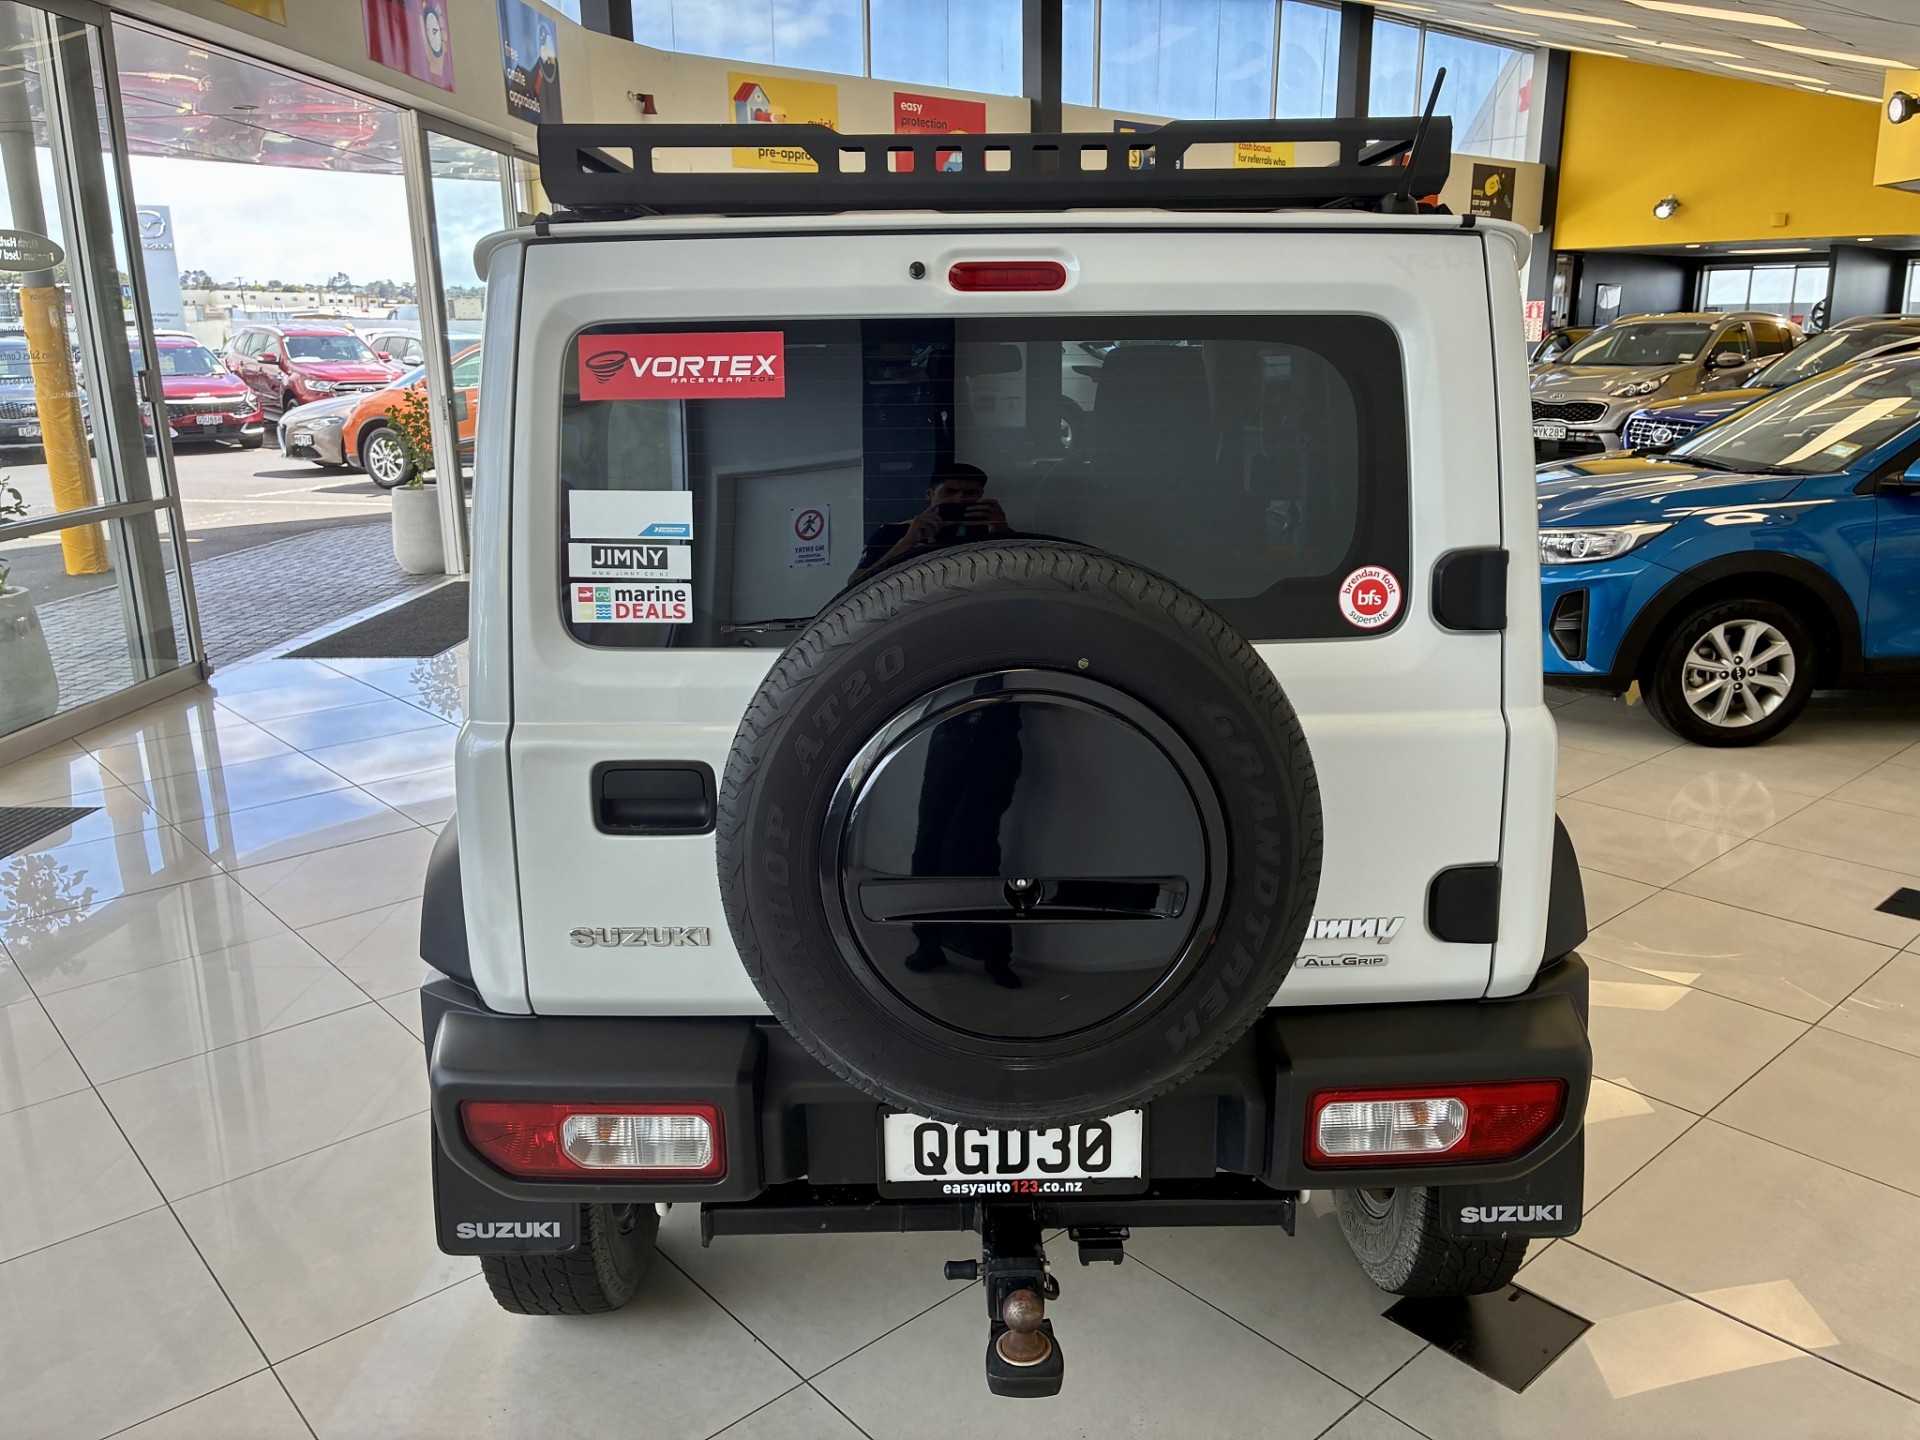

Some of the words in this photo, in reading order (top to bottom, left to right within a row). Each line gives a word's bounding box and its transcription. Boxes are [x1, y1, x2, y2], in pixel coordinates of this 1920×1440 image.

[504, 40, 519, 61] free
[507, 66, 526, 87] onsite
[509, 89, 541, 114] appraisals
[900, 101, 923, 114] easy
[901, 115, 948, 130] protection
[1238, 142, 1252, 150] cash
[1253, 144, 1272, 153] bonus
[1238, 152, 1247, 162] for
[1247, 154, 1272, 165] referrals
[1272, 157, 1286, 166] who
[629, 354, 778, 378] VORTEX
[594, 546, 664, 568] JIMNY
[1342, 569, 1380, 595] brendan
[1381, 573, 1396, 594] foot
[614, 586, 686, 602] marine
[1357, 589, 1382, 606] bfs
[615, 603, 686, 620] DEALS
[1348, 610, 1389, 624] supersite
[793, 645, 906, 777] AT20
[569, 926, 711, 948] SUZUKI
[913, 1120, 1112, 1176] QGD30
[943, 1181, 1083, 1197] easyauto123.co.nz
[1460, 1204, 1563, 1224] SUZUKI
[456, 1221, 561, 1239] SUZUKI
